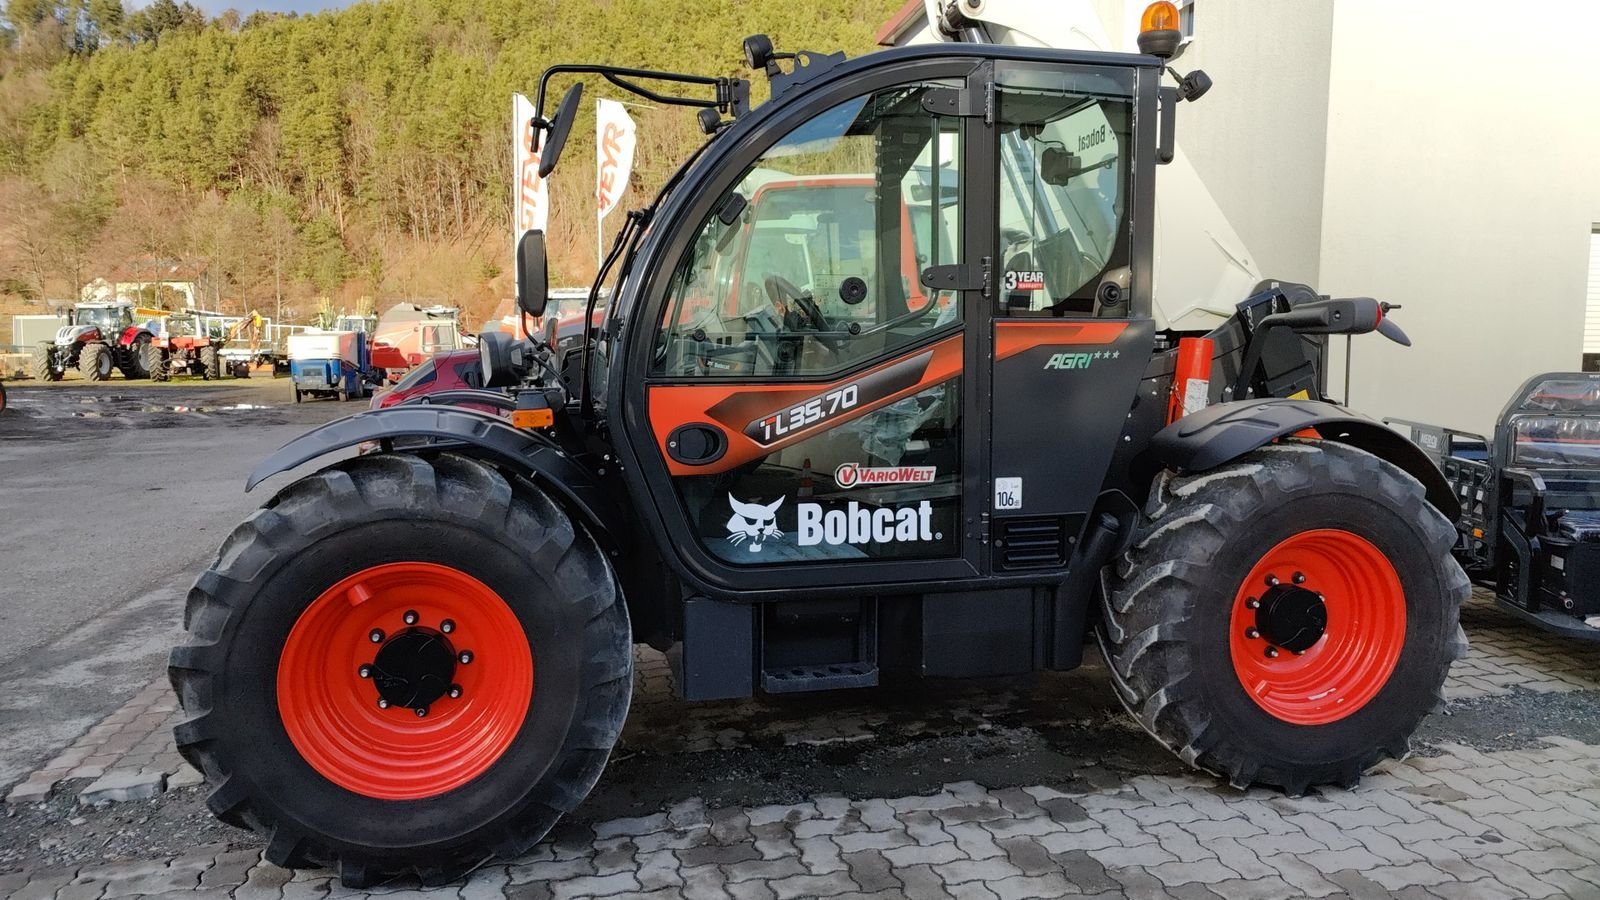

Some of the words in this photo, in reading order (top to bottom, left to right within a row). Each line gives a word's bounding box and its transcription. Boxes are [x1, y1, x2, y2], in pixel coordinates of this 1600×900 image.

[1005, 271, 1017, 290] 3
[1017, 271, 1044, 283] YEAR
[1043, 353, 1093, 370] AGRI
[759, 384, 858, 440] TL35.70
[996, 491, 1014, 507] 106
[798, 500, 933, 546] Bobcat
